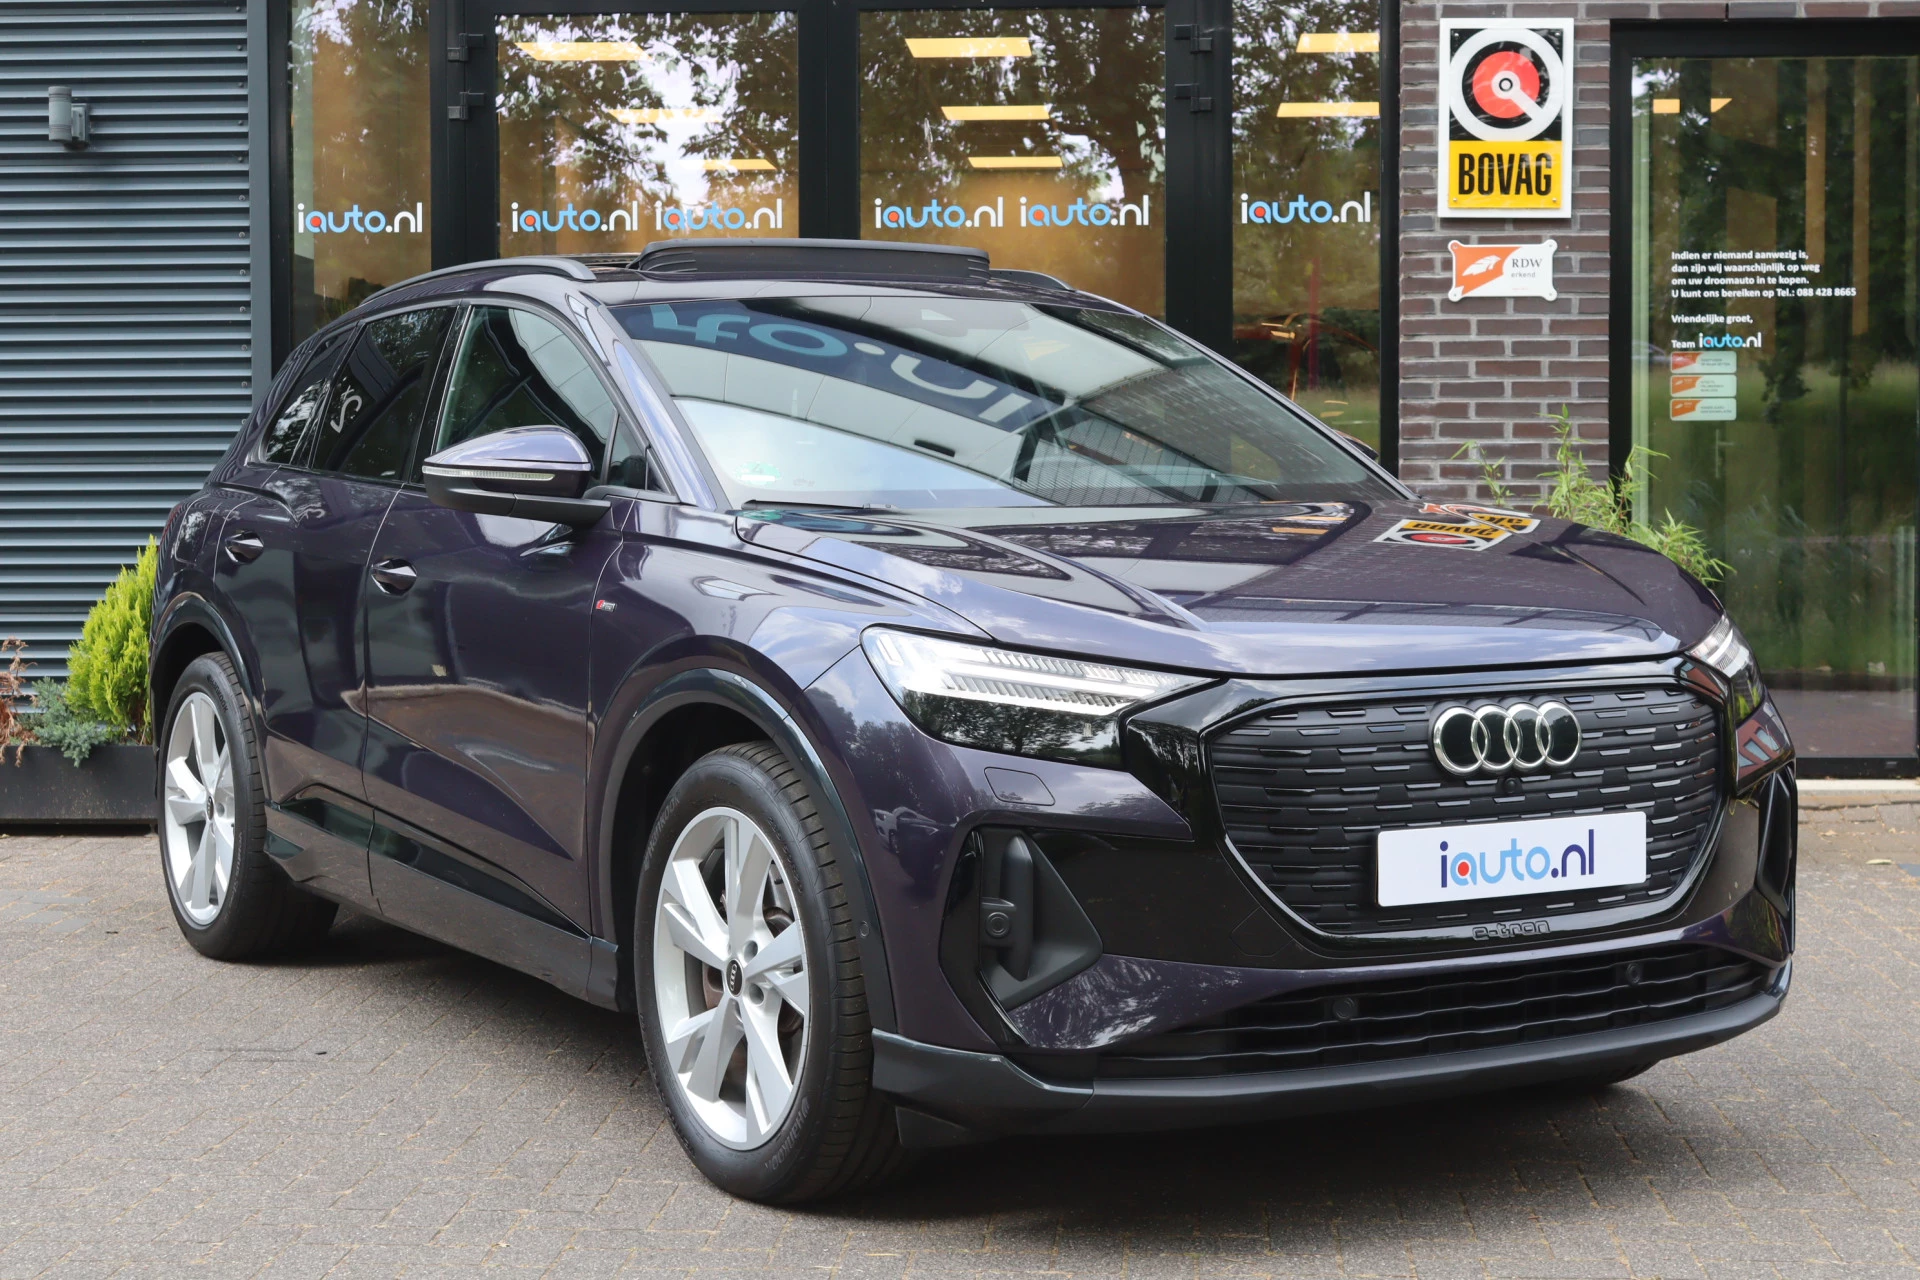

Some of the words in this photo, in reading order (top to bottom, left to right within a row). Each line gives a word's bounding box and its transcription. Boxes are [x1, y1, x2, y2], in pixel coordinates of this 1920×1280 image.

[1458, 152, 1552, 196] BOVAG
[297, 202, 423, 234] iauto.nl
[511, 200, 638, 233] iauto.nl
[655, 198, 783, 231] iauto.nl
[874, 196, 1003, 229] iauto.nl
[1019, 194, 1149, 227] iauto.nl
[1241, 191, 1371, 224] iauto.nl
[1512, 258, 1543, 269] RDW
[1671, 250, 1700, 260] Indien
[1701, 252, 1712, 260] er
[1713, 250, 1754, 260] niemand
[1755, 250, 1797, 260] aanwezig
[1798, 249, 1809, 260] is,
[1671, 263, 1689, 273] dan
[1690, 263, 1707, 274] zijn
[1708, 263, 1723, 274] wij
[1724, 262, 1786, 274] waarschijnlijk
[1786, 264, 1800, 273] op
[1801, 264, 1821, 273] weg
[1671, 278, 1687, 286] om
[1704, 275, 1755, 285] droomauto
[1756, 275, 1766, 285] in
[1767, 276, 1777, 285] te
[1778, 275, 1810, 286] kopen.
[1671, 289, 1679, 298] U
[1680, 288, 1702, 298] kunt
[1703, 290, 1720, 298] ons
[1721, 288, 1761, 297] bereiken
[1762, 289, 1775, 299] op
[1776, 288, 1796, 297] Tel.:
[1796, 287, 1814, 297] 088
[1815, 287, 1833, 297] 428
[1833, 287, 1857, 297] 8665
[1671, 314, 1725, 325] Vriendelijke
[1726, 314, 1754, 325] groet,
[1671, 339, 1696, 349] Team
[1698, 331, 1762, 349] iauto.nl
[1440, 828, 1595, 889] iauto.nl
[1472, 920, 1551, 941] e-tron
